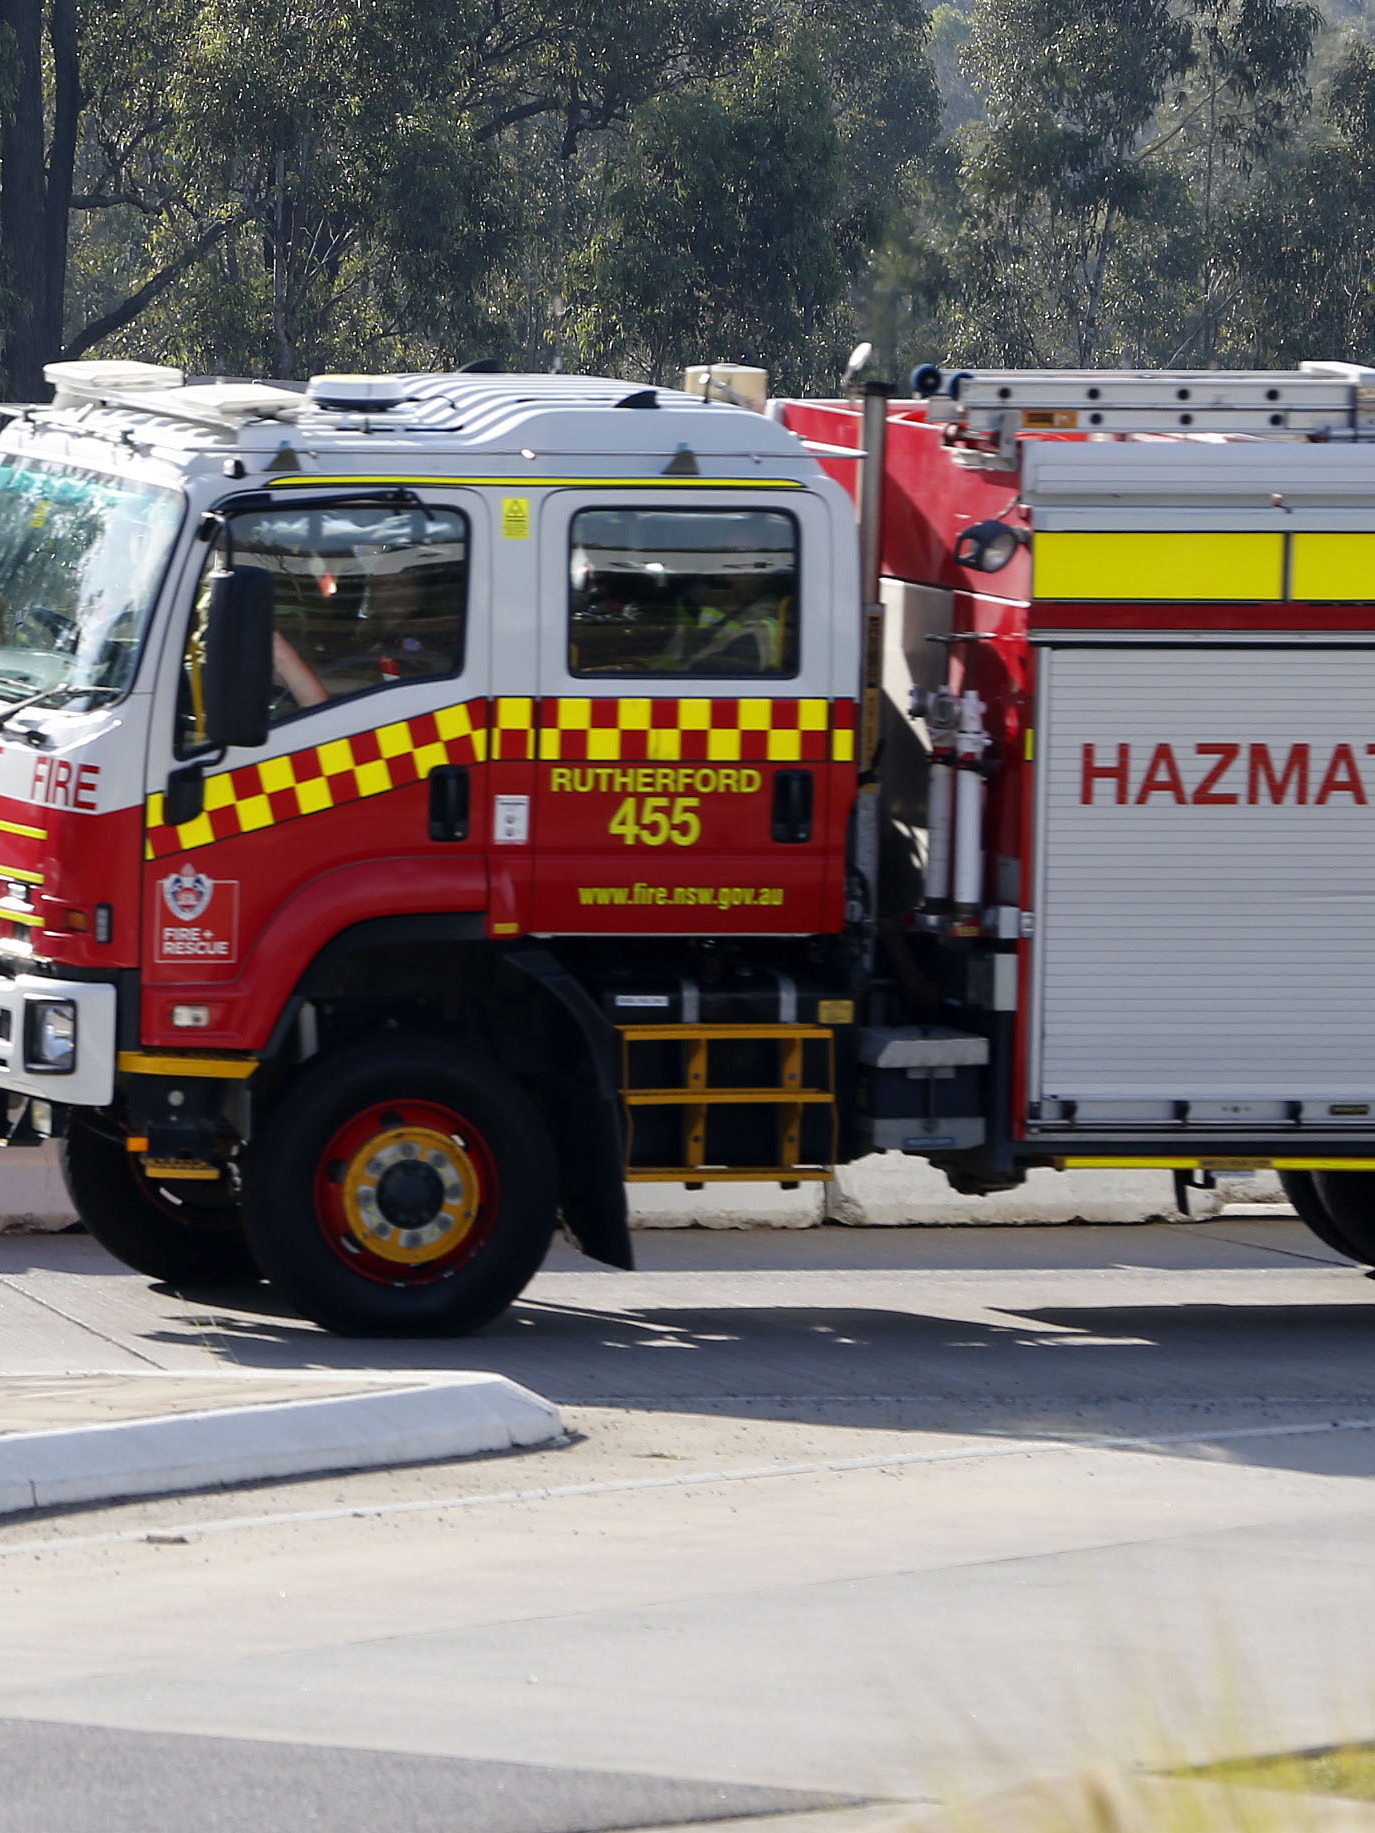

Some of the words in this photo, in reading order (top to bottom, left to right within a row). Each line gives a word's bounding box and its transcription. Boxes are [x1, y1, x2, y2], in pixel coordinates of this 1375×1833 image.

[31, 756, 100, 811] FIRE
[551, 768, 762, 793] RUTHERFORD
[1080, 743, 1375, 805] HAZMA
[608, 797, 702, 846] 455
[579, 882, 784, 910] www.fire.nsw.gov.au
[163, 927, 201, 941] FIRE
[163, 941, 229, 955] RESCUE
